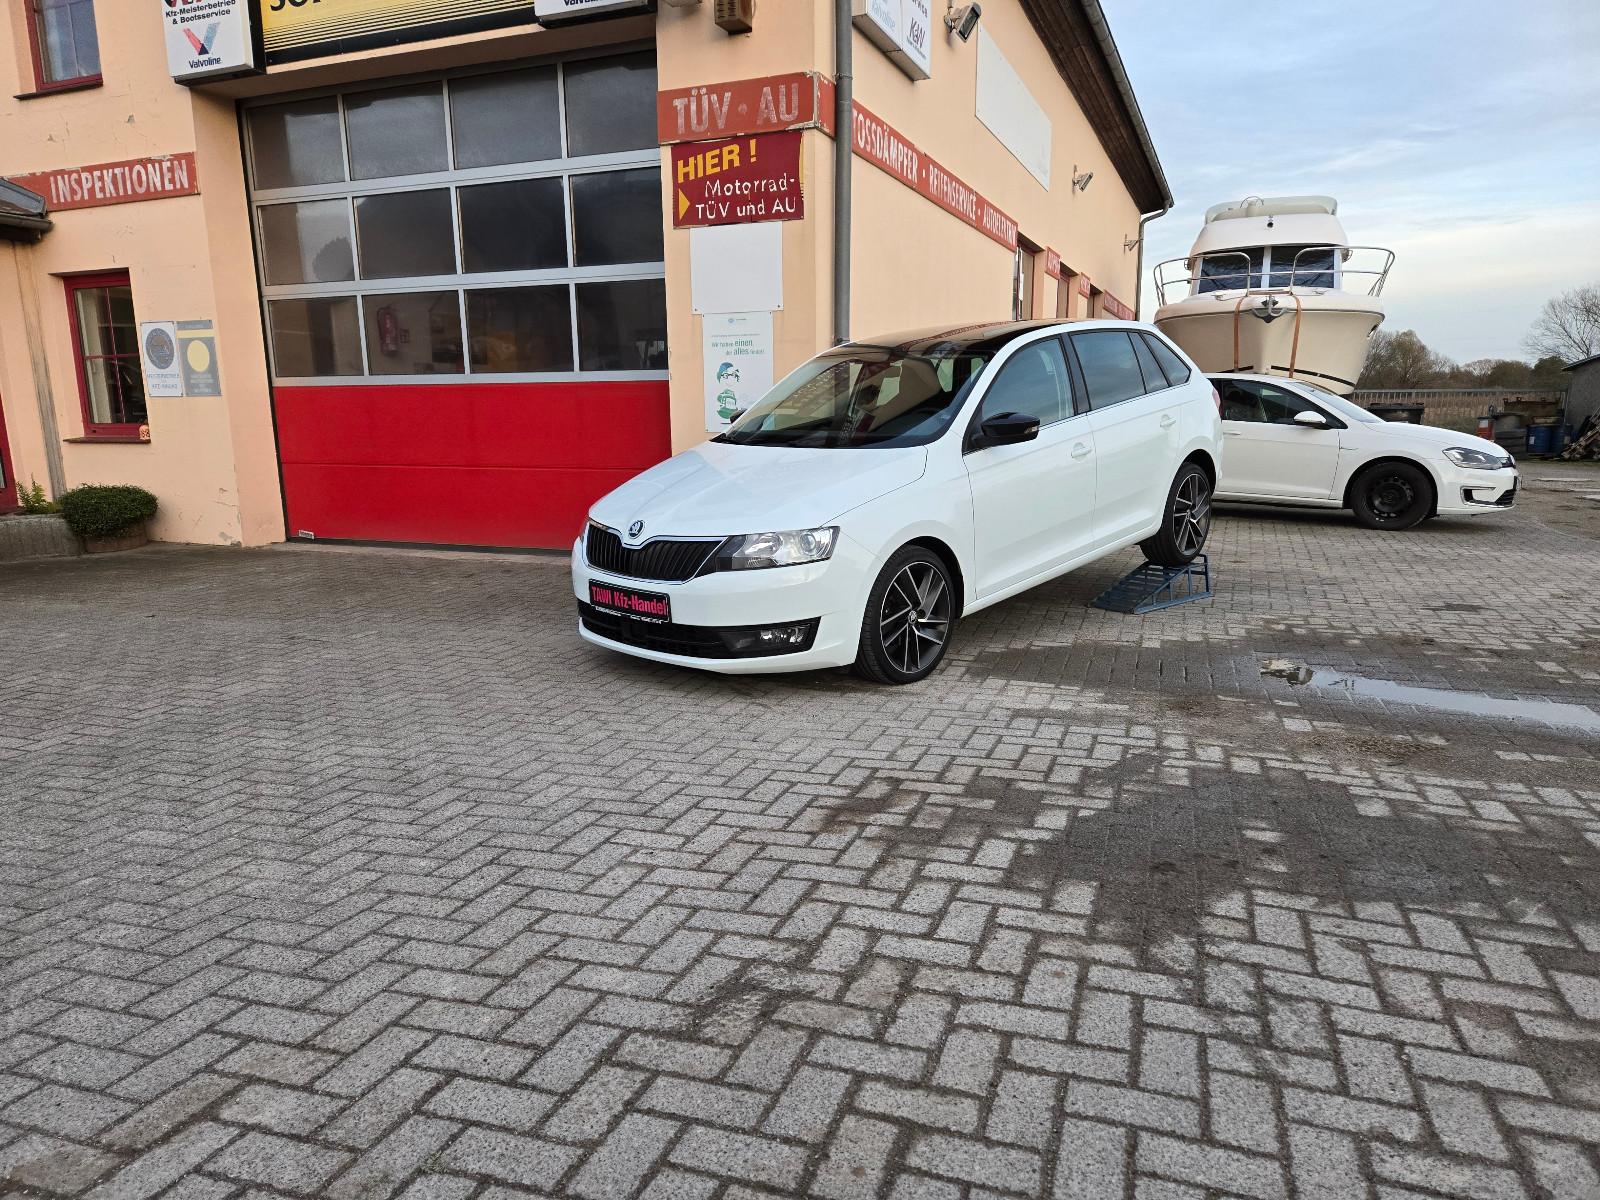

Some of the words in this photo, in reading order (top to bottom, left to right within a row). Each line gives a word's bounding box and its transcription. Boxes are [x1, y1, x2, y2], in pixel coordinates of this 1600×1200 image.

[165, 0, 236, 17] Kfz-Meisterbetrieb
[180, 8, 231, 24] Bootsservice
[188, 57, 222, 69] Valvoline
[672, 87, 732, 135] TÜV
[756, 83, 799, 125] AU
[677, 143, 740, 184] HIER
[49, 159, 189, 203] INSPEKTIONEN
[705, 173, 795, 198] Motorrad-
[929, 163, 977, 221] REIFENSERVICE
[695, 198, 730, 220] TÜV
[736, 202, 765, 217] und
[771, 196, 796, 214] AU
[733, 347, 749, 355] alles
[591, 586, 612, 606] TAWI
[614, 591, 668, 616] Kfz-Handel
